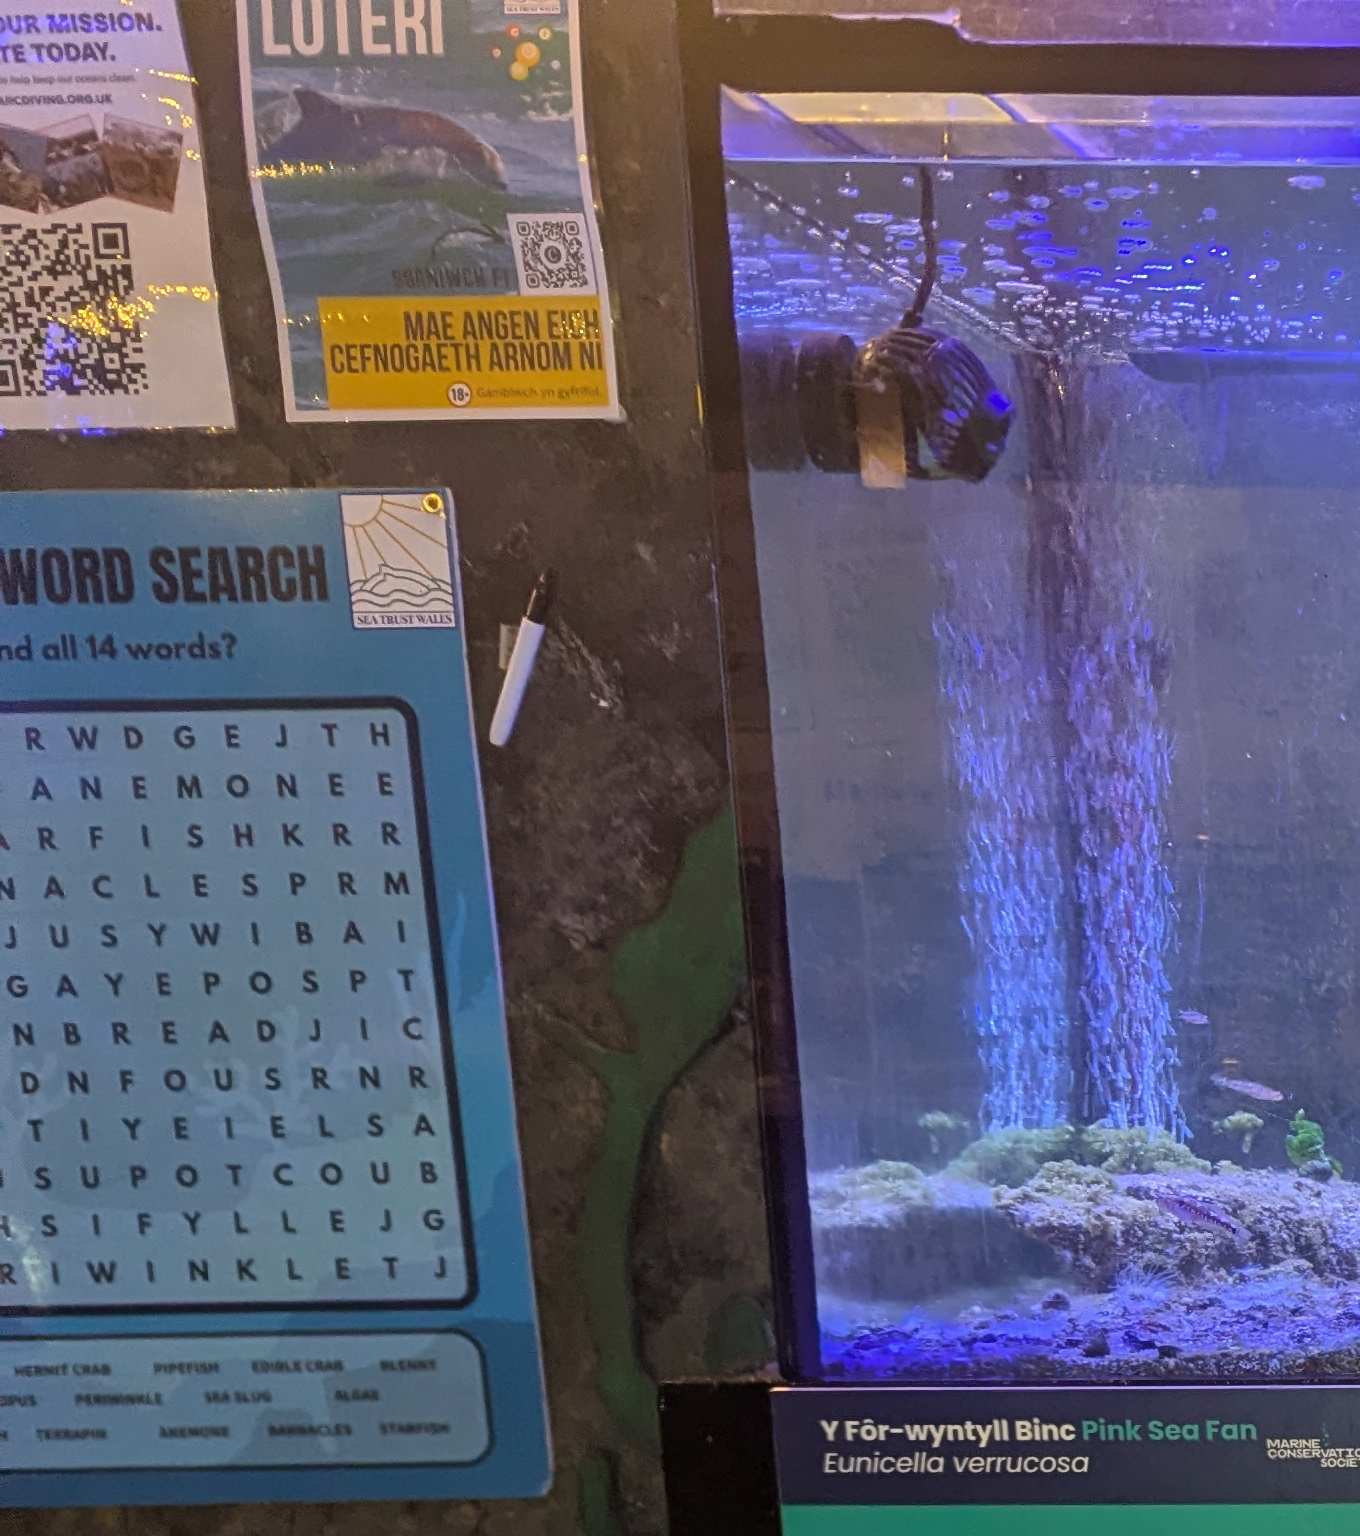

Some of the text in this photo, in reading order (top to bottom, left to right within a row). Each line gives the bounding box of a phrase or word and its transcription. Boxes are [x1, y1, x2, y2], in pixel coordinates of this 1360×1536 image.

[47, 12, 162, 33] MISSION.
[31, 41, 116, 63] TODAY.
[403, 310, 456, 341] MAE
[462, 310, 539, 341] ANGEN
[330, 342, 482, 374] CEFNOGAETH
[488, 342, 572, 373] ARNOM
[0, 545, 330, 605] WORD SEARCH
[357, 615, 378, 625] SEA
[380, 615, 413, 624] TRUST
[42, 631, 236, 660] all 14 words?
[820, 1417, 1256, 1447] Y Fôr-wyntyll Binc Pink Sea Fan
[1266, 1438, 1321, 1449] MARINE
[824, 1451, 1089, 1473] Eunicella verrucosa
